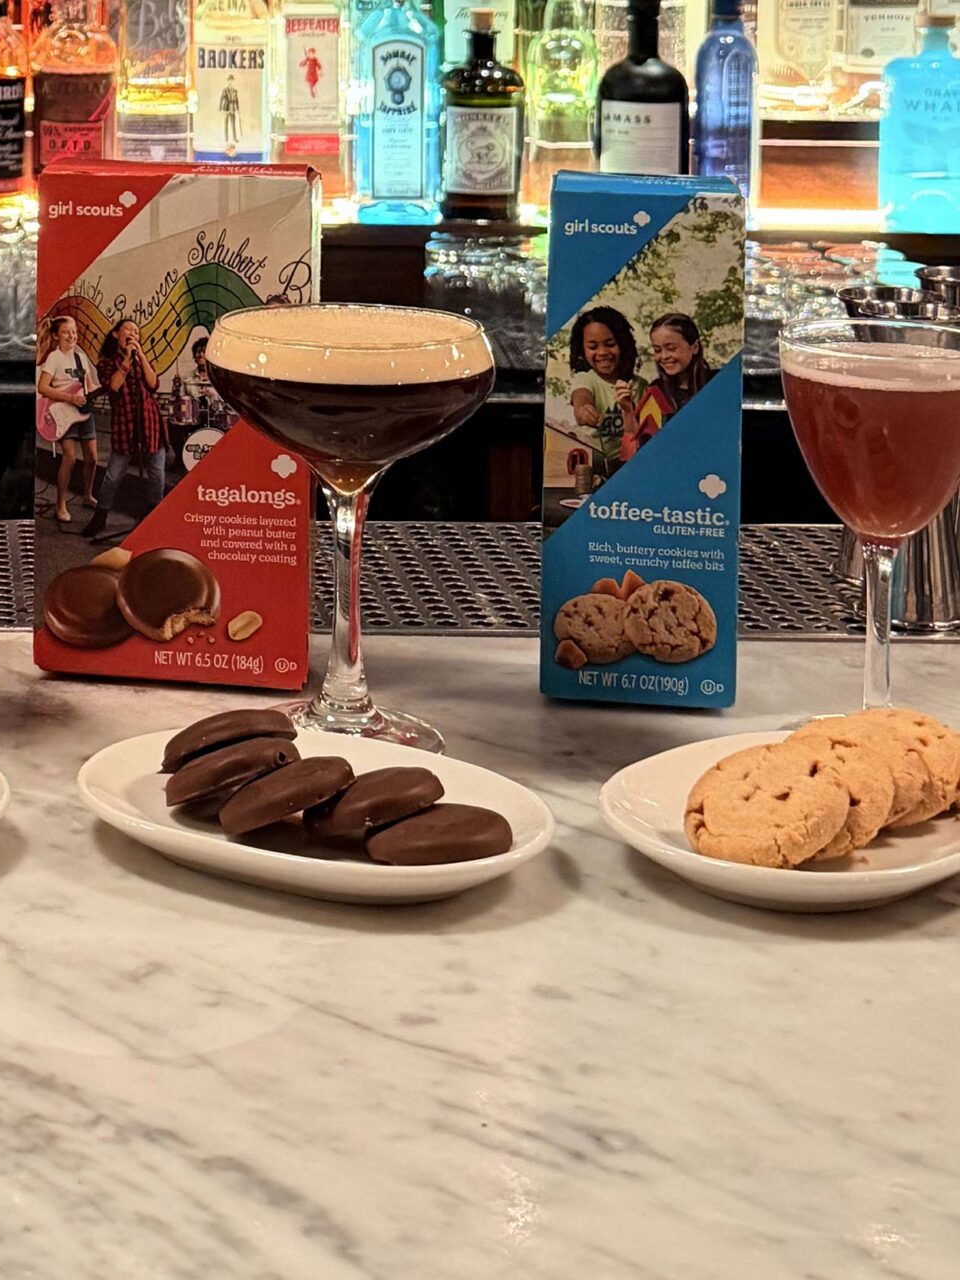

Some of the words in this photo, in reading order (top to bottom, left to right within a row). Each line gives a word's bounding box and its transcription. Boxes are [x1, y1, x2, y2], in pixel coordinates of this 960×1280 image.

[285, 16, 339, 34] BEEFEATER
[380, 50, 418, 65] BOMBAY
[48, 201, 73, 218] girl
[76, 204, 123, 217] scouts
[565, 220, 588, 236] girl
[591, 222, 638, 235] scouts
[187, 228, 268, 285] Schubert
[197, 484, 297, 509] tagalongs
[184, 513, 216, 525] Crispy
[218, 514, 258, 525] cookies
[259, 516, 297, 527] layered
[589, 501, 725, 526] toffee-tastic
[203, 526, 226, 537] with
[228, 528, 264, 539] peanut
[266, 529, 297, 539] butter
[653, 524, 726, 538] GLUTEN-FREE
[200, 537, 221, 548] and
[222, 539, 263, 550] covered
[265, 540, 288, 551] with
[588, 542, 614, 553] Rich,
[616, 543, 655, 557] buttery
[657, 547, 699, 558] cookies
[700, 549, 725, 560] with
[207, 549, 257, 563] chocolaty
[258, 552, 297, 566] coating
[589, 554, 622, 566] sweet,
[624, 556, 669, 570] crunchy
[671, 558, 704, 570] toffee
[705, 560, 726, 571] bits
[154, 650, 174, 665] NET
[175, 652, 193, 666] WT
[195, 653, 211, 667] 6.5
[213, 655, 229, 668] OZ
[231, 655, 264, 674] (184g)
[578, 670, 597, 686] NET
[601, 672, 619, 687] WT
[621, 674, 637, 688] 6.7
